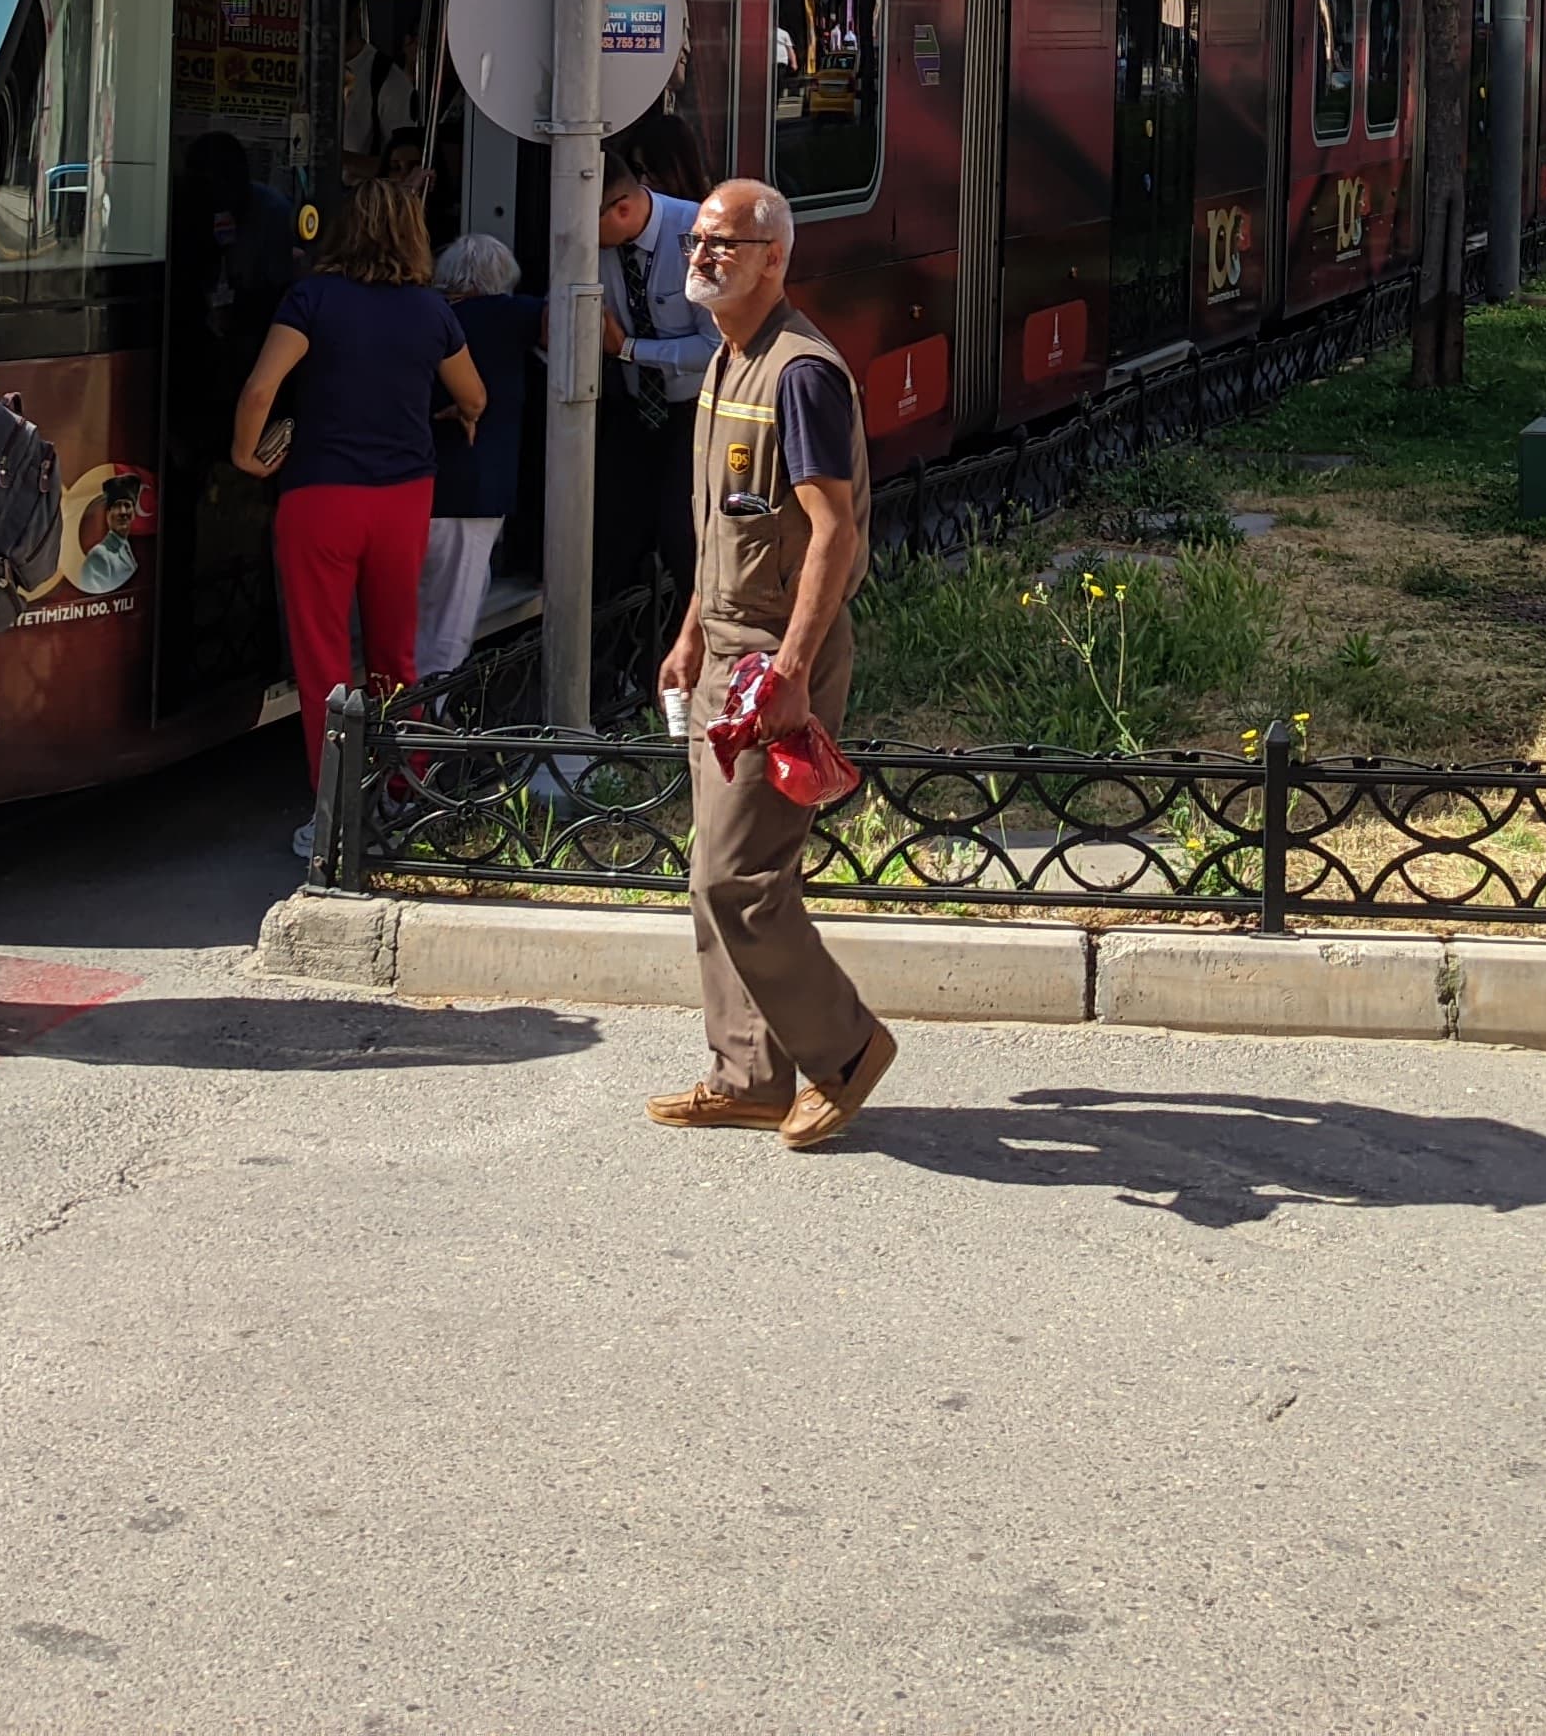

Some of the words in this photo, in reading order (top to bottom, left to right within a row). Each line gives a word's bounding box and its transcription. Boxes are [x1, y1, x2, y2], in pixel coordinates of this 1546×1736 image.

[631, 10, 662, 22] KREDİ
[603, 22, 626, 33] AYLI
[113, 597, 134, 613] YILI
